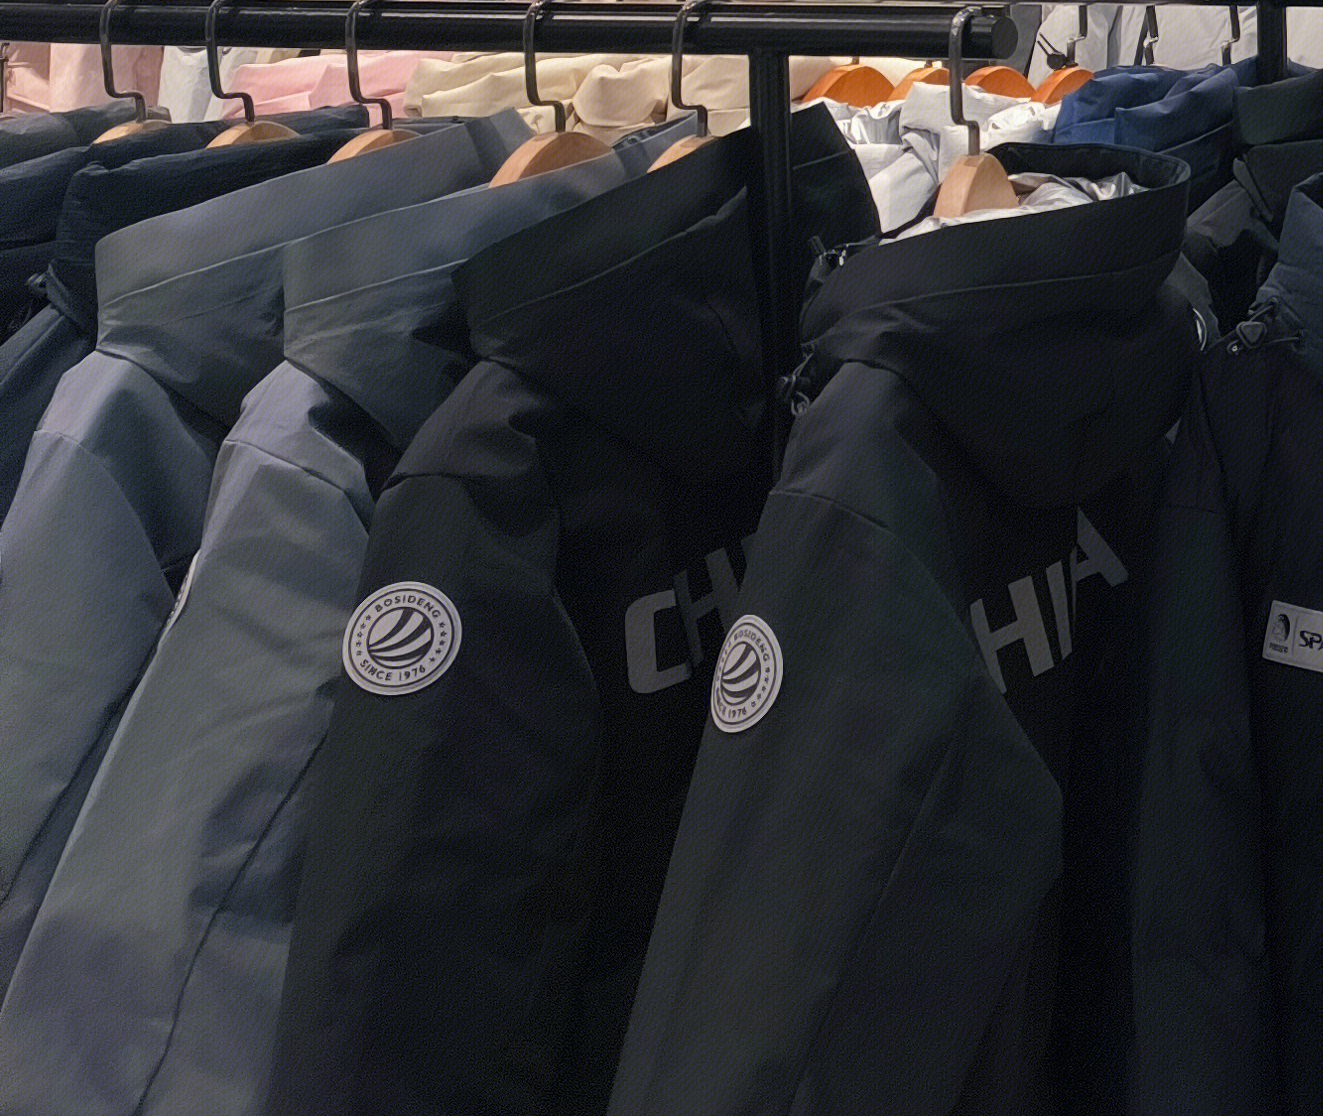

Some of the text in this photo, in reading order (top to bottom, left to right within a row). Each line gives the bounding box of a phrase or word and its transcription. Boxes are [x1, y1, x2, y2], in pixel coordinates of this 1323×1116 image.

[375, 594, 441, 618] BOSIDENG
[734, 629, 771, 662] BOSIDENG
[360, 658, 426, 681] SINCE 1976
